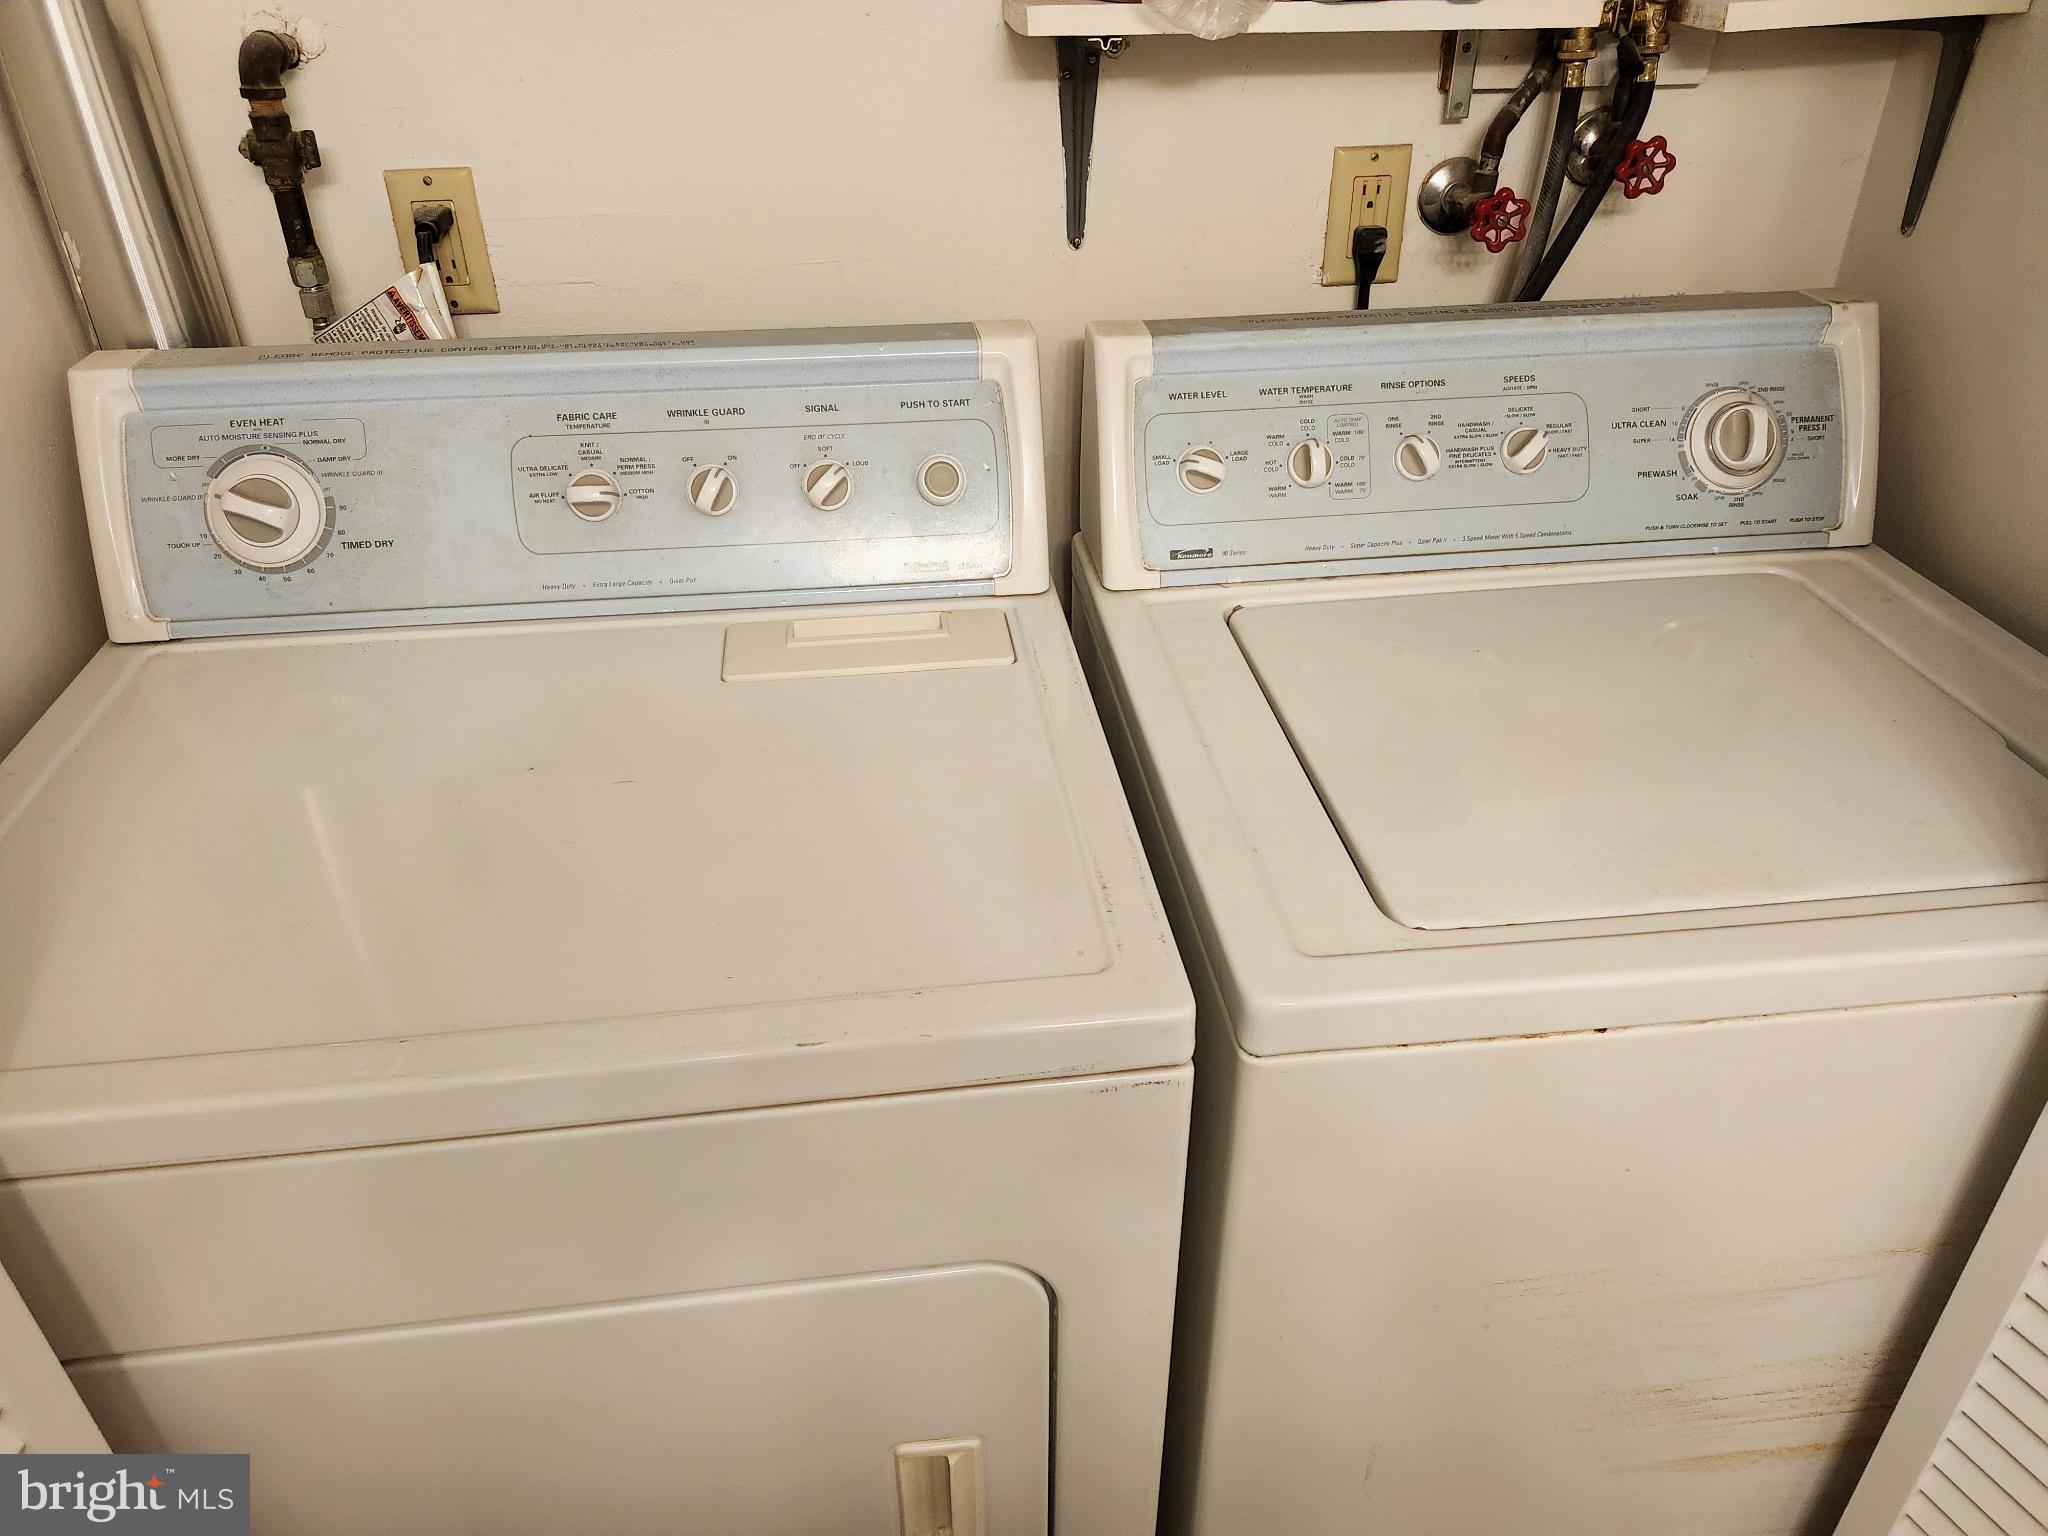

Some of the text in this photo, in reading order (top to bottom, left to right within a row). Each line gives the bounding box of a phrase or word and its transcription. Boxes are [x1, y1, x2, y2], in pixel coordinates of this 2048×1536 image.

[1503, 375, 1536, 383] SPEEDS
[1380, 379, 1446, 390] RINSE OPTIONS
[1168, 390, 1227, 400] WATER LEVEL
[1259, 384, 1353, 396] WATER TEMPERATURE
[805, 404, 840, 413] SIGNAL
[900, 399, 971, 409] PUSH TO START
[556, 411, 618, 422] FABRIC CARE
[667, 407, 746, 418] WRINKLE GUARD
[230, 418, 284, 428] EVEN HEAT
[1611, 419, 1667, 429] ULTRA CLEAN
[1791, 415, 1834, 423] PERMANENT
[222, 433, 261, 441] MOISTURE
[263, 431, 297, 439] SENSING
[298, 430, 319, 438] PLUS
[1637, 470, 1678, 478] PREWASH
[172, 494, 196, 502] GUARD
[1675, 493, 1698, 501] SOAK
[1367, 541, 1390, 549] Capacity
[1466, 535, 1484, 543] Speed
[1519, 531, 1537, 539] Speed
[1536, 530, 1572, 538] Combinations
[341, 540, 394, 550] TIMED DRY
[1177, 552, 1213, 560] Kenmore
[542, 584, 559, 592] Heavy
[609, 580, 627, 589] Large
[627, 578, 653, 587] Capacity
